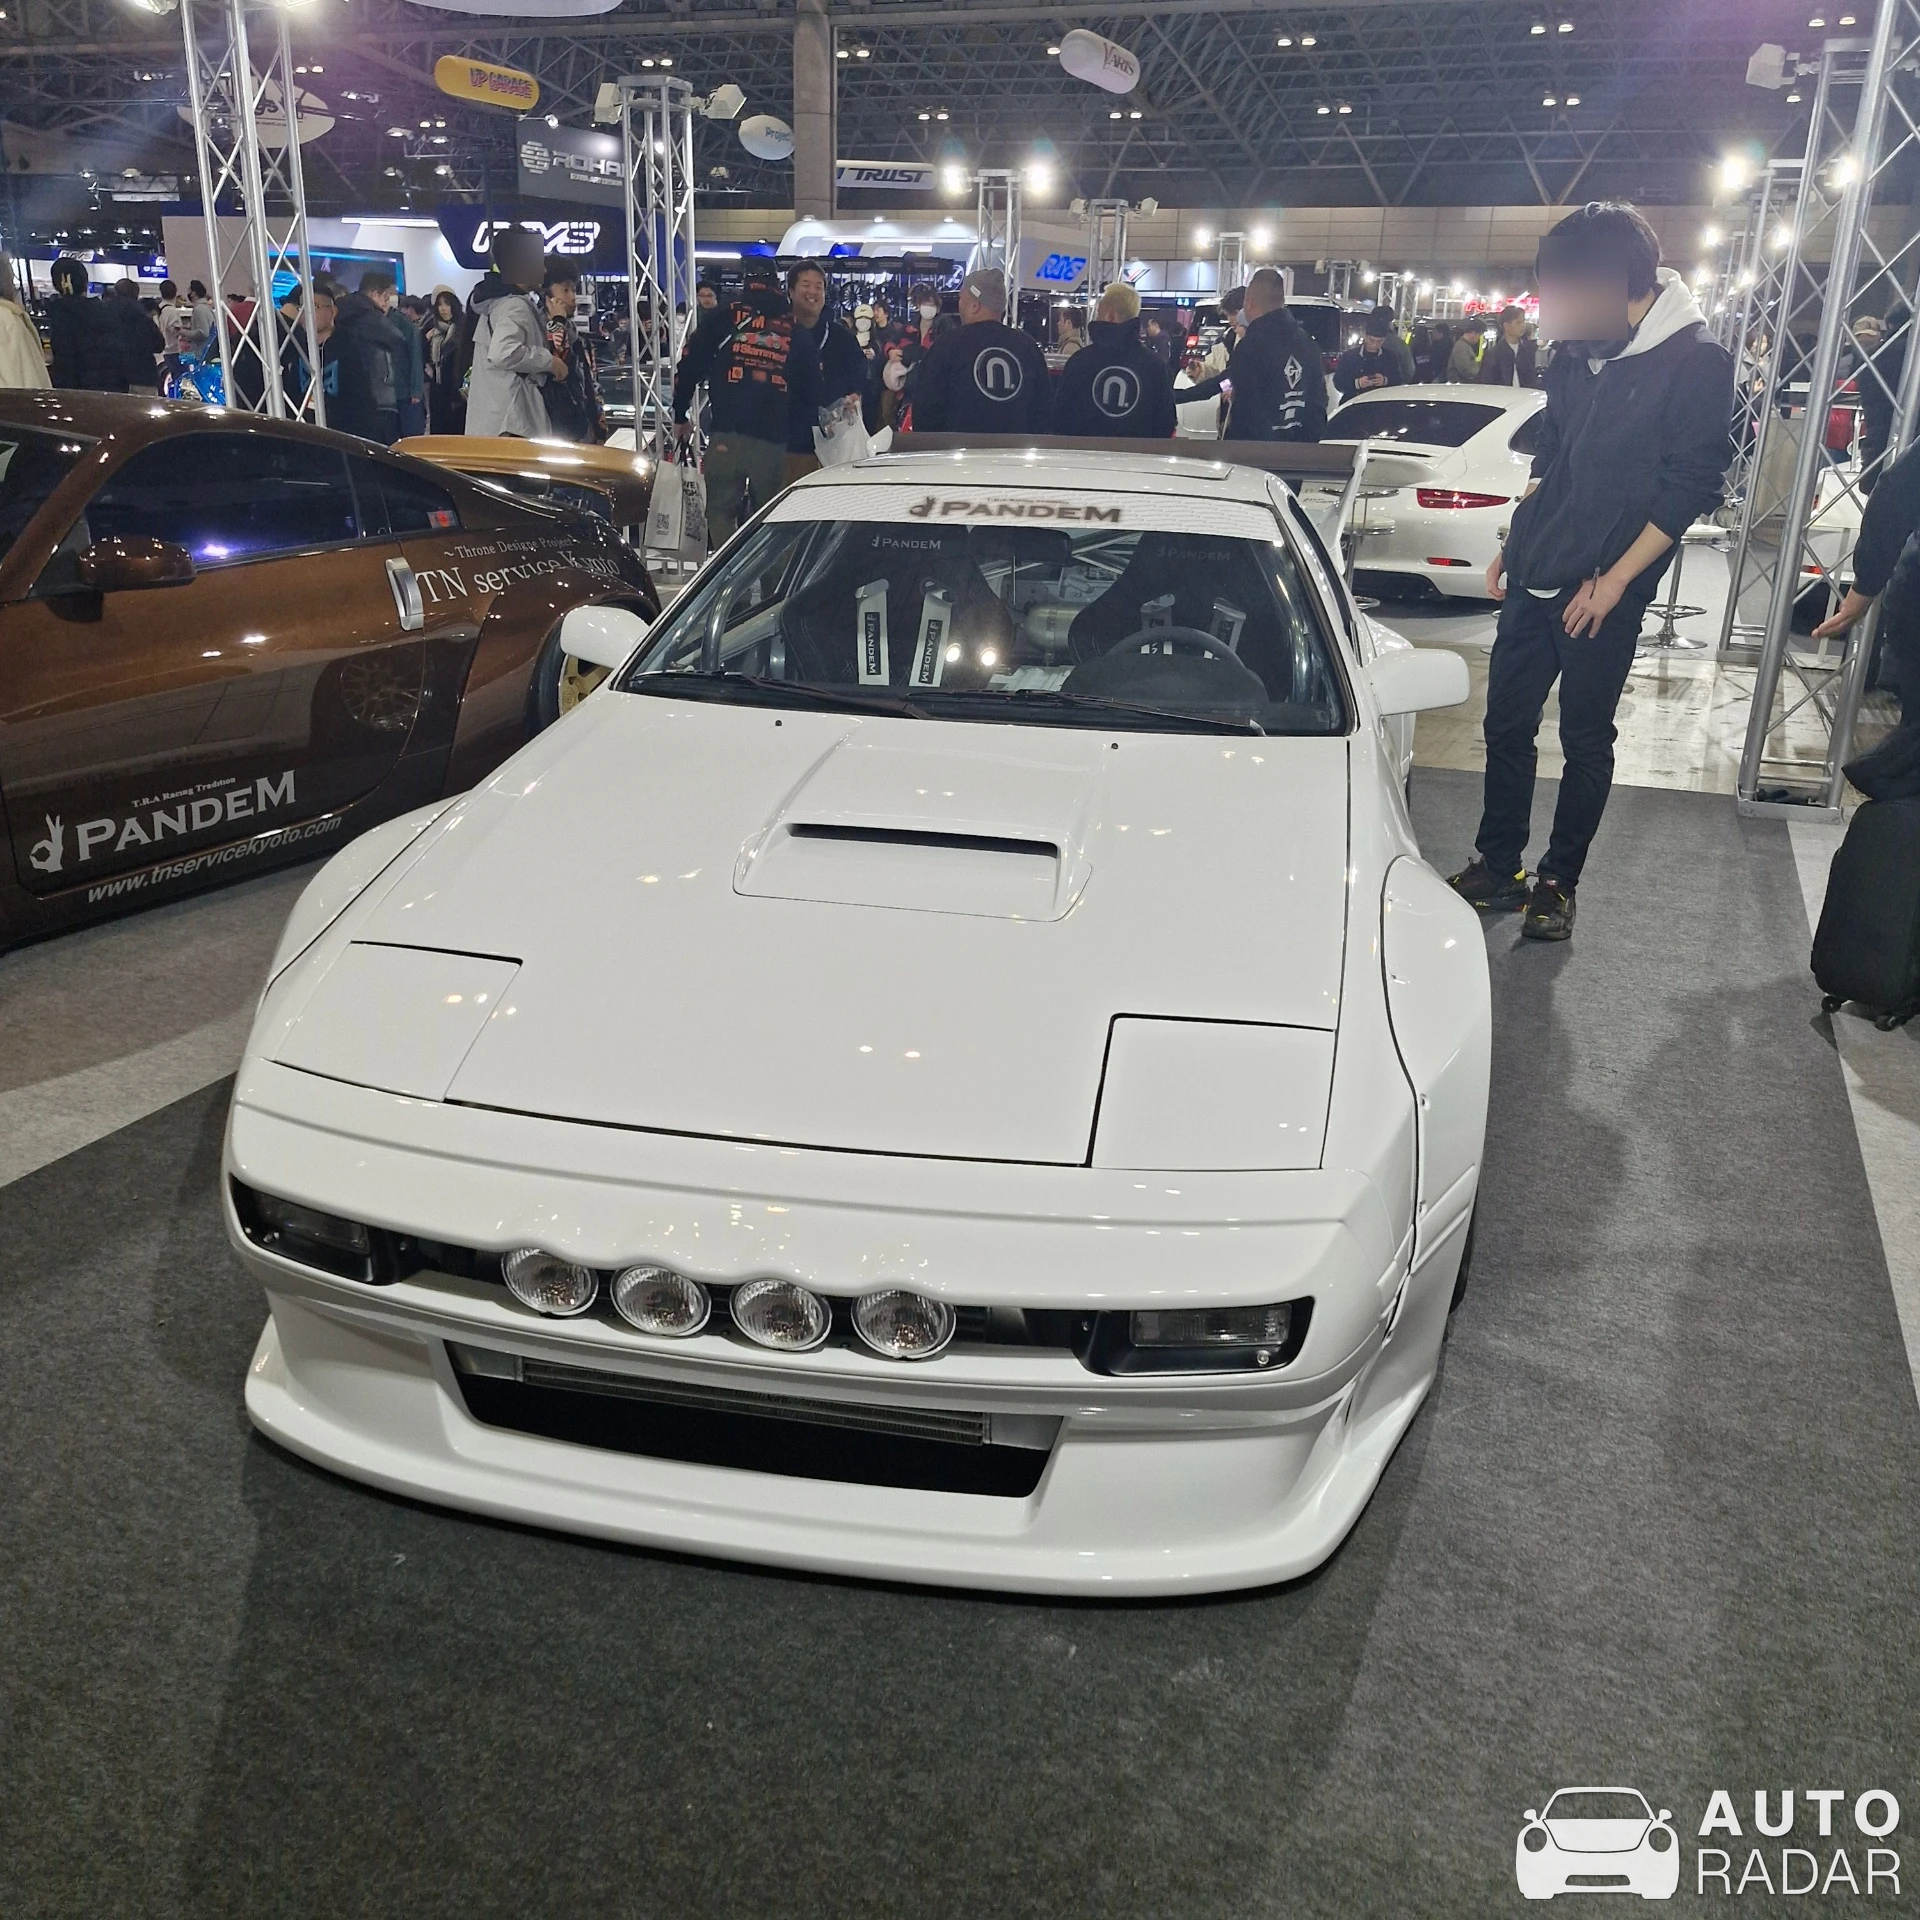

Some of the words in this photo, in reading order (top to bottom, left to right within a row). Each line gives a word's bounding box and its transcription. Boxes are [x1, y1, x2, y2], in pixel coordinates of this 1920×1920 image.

[469, 67, 488, 88] UP
[489, 72, 533, 99] GARAGE
[765, 127, 790, 142] Projec
[848, 167, 933, 183] TRUST
[472, 221, 601, 254] RYS
[940, 501, 1121, 523] PANDEM
[498, 539, 539, 553] Designe
[882, 538, 941, 550] PANDEM
[415, 567, 469, 603] TN
[473, 555, 562, 594] service
[921, 631, 937, 682] PANDEM
[162, 788, 194, 801] Racing
[195, 777, 236, 792] Tradition
[75, 770, 297, 862] PANDEM
[88, 816, 343, 903] www.tnservicekyoto.com
